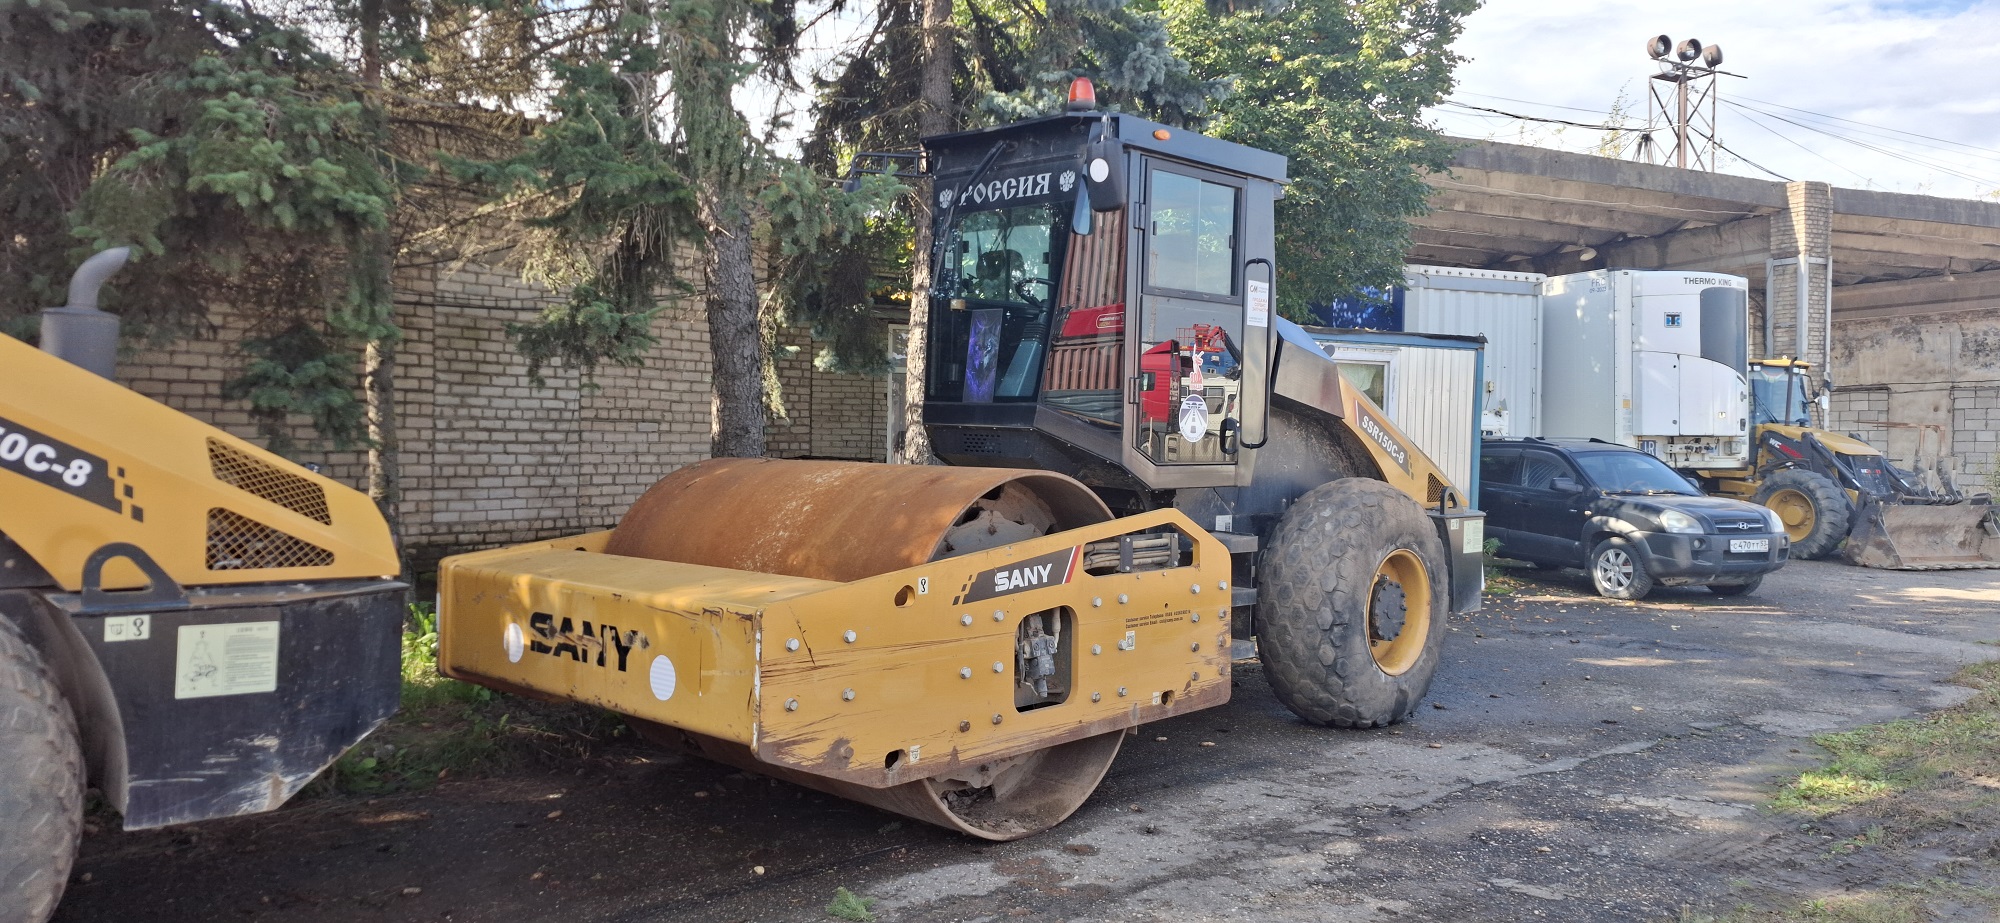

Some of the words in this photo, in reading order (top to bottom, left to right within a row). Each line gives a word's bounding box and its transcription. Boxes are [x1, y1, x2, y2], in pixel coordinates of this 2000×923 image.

[1683, 277, 1716, 285] THERMO
[1718, 278, 1732, 286] KING
[0, 426, 93, 487] 0C-8
[1362, 415, 1405, 464] SSR150C-8
[994, 563, 1053, 592] SANY
[530, 611, 641, 672] SANY
